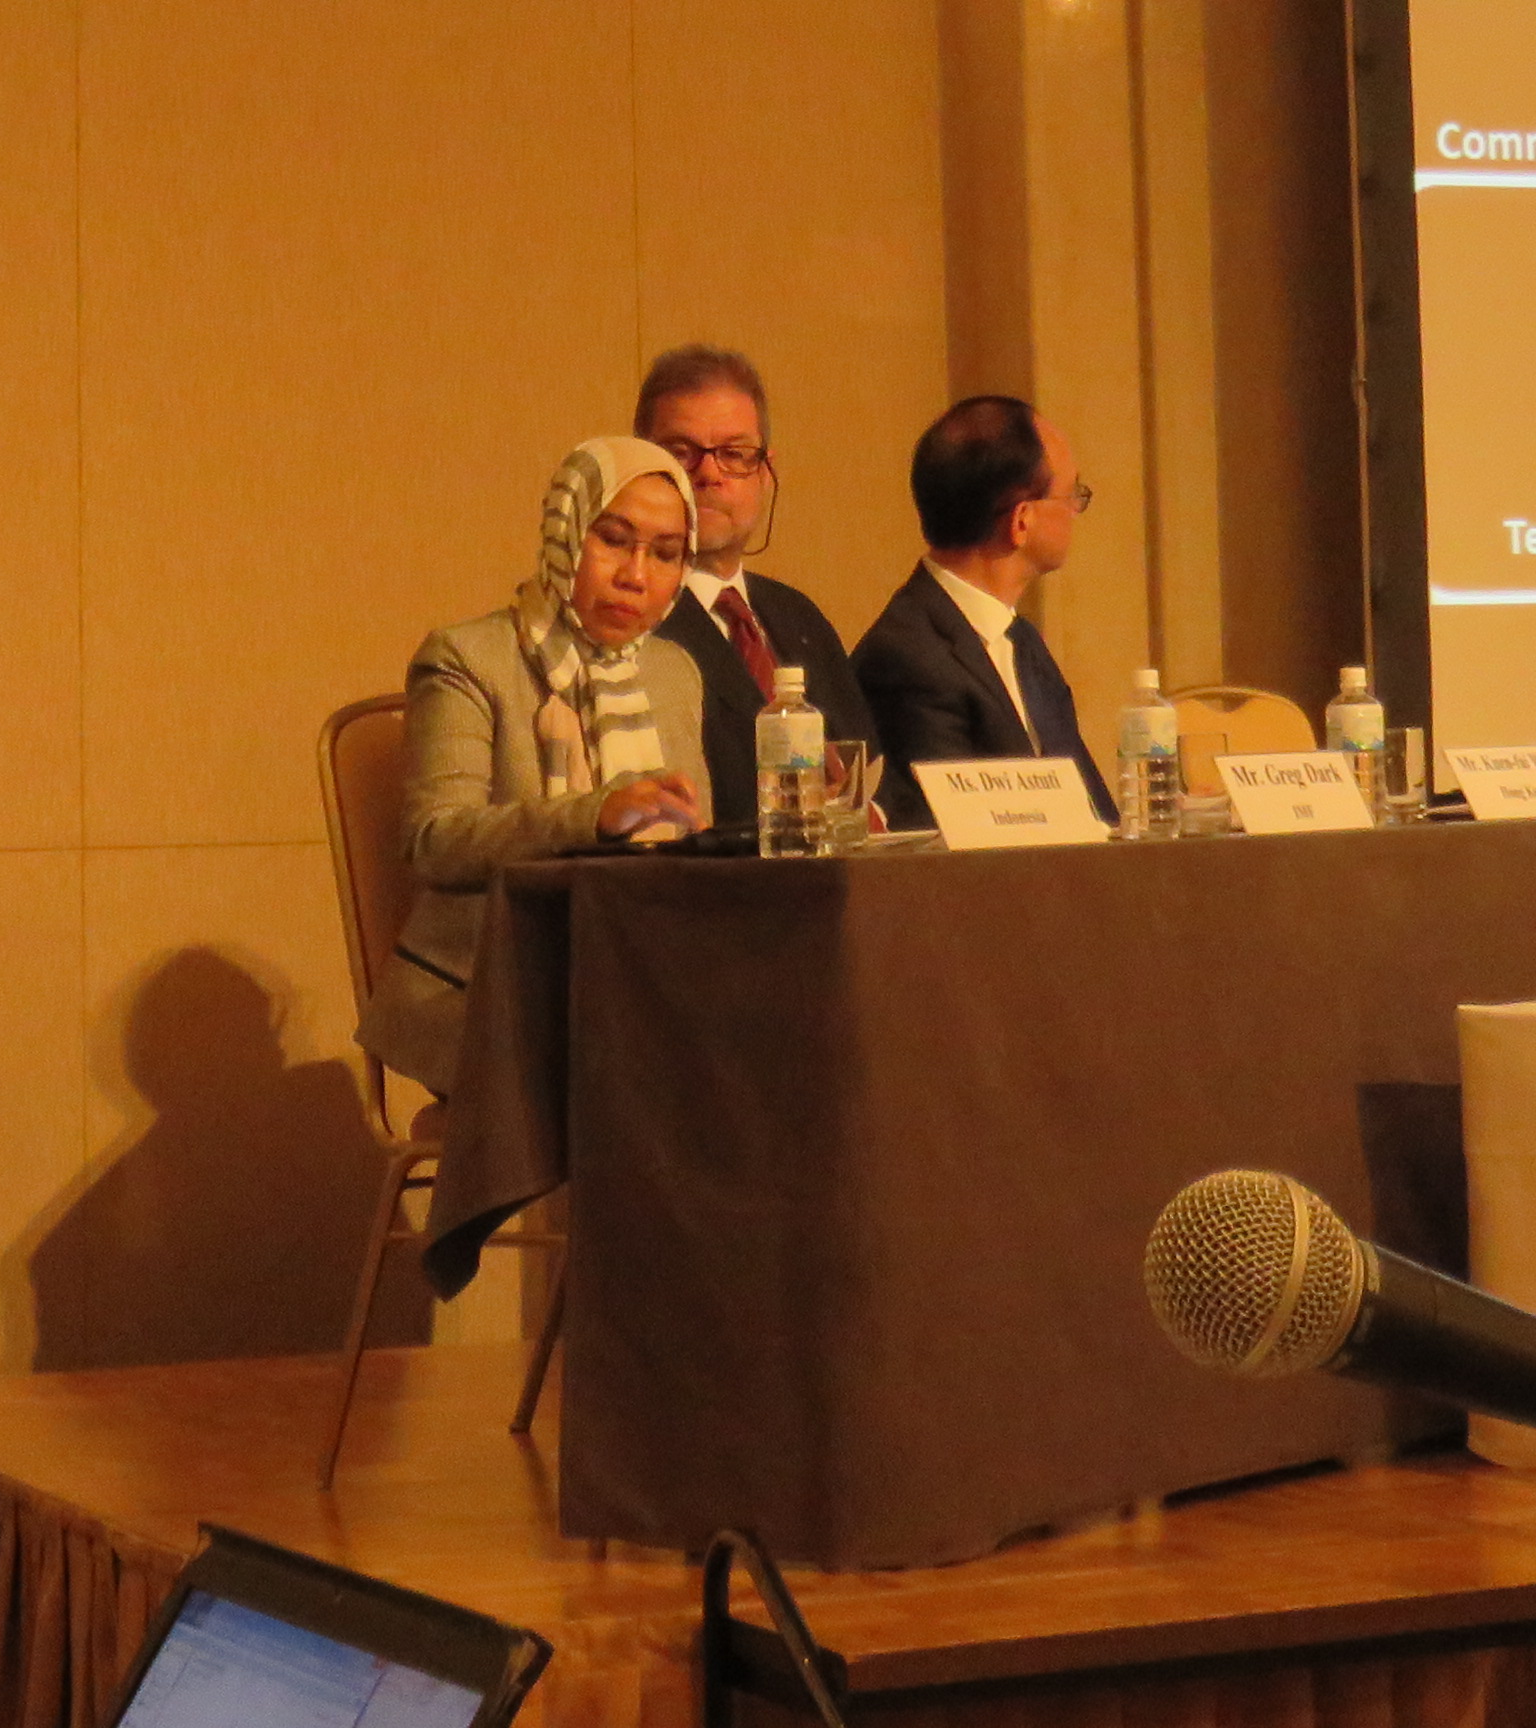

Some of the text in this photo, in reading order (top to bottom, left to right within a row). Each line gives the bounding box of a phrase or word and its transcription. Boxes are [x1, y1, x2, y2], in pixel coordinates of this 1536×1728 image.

[945, 769, 1063, 793] Ms. Dwi Astuti
[1231, 762, 1343, 791] Mr. Greg Dark
[990, 808, 1049, 827] Indonesia
